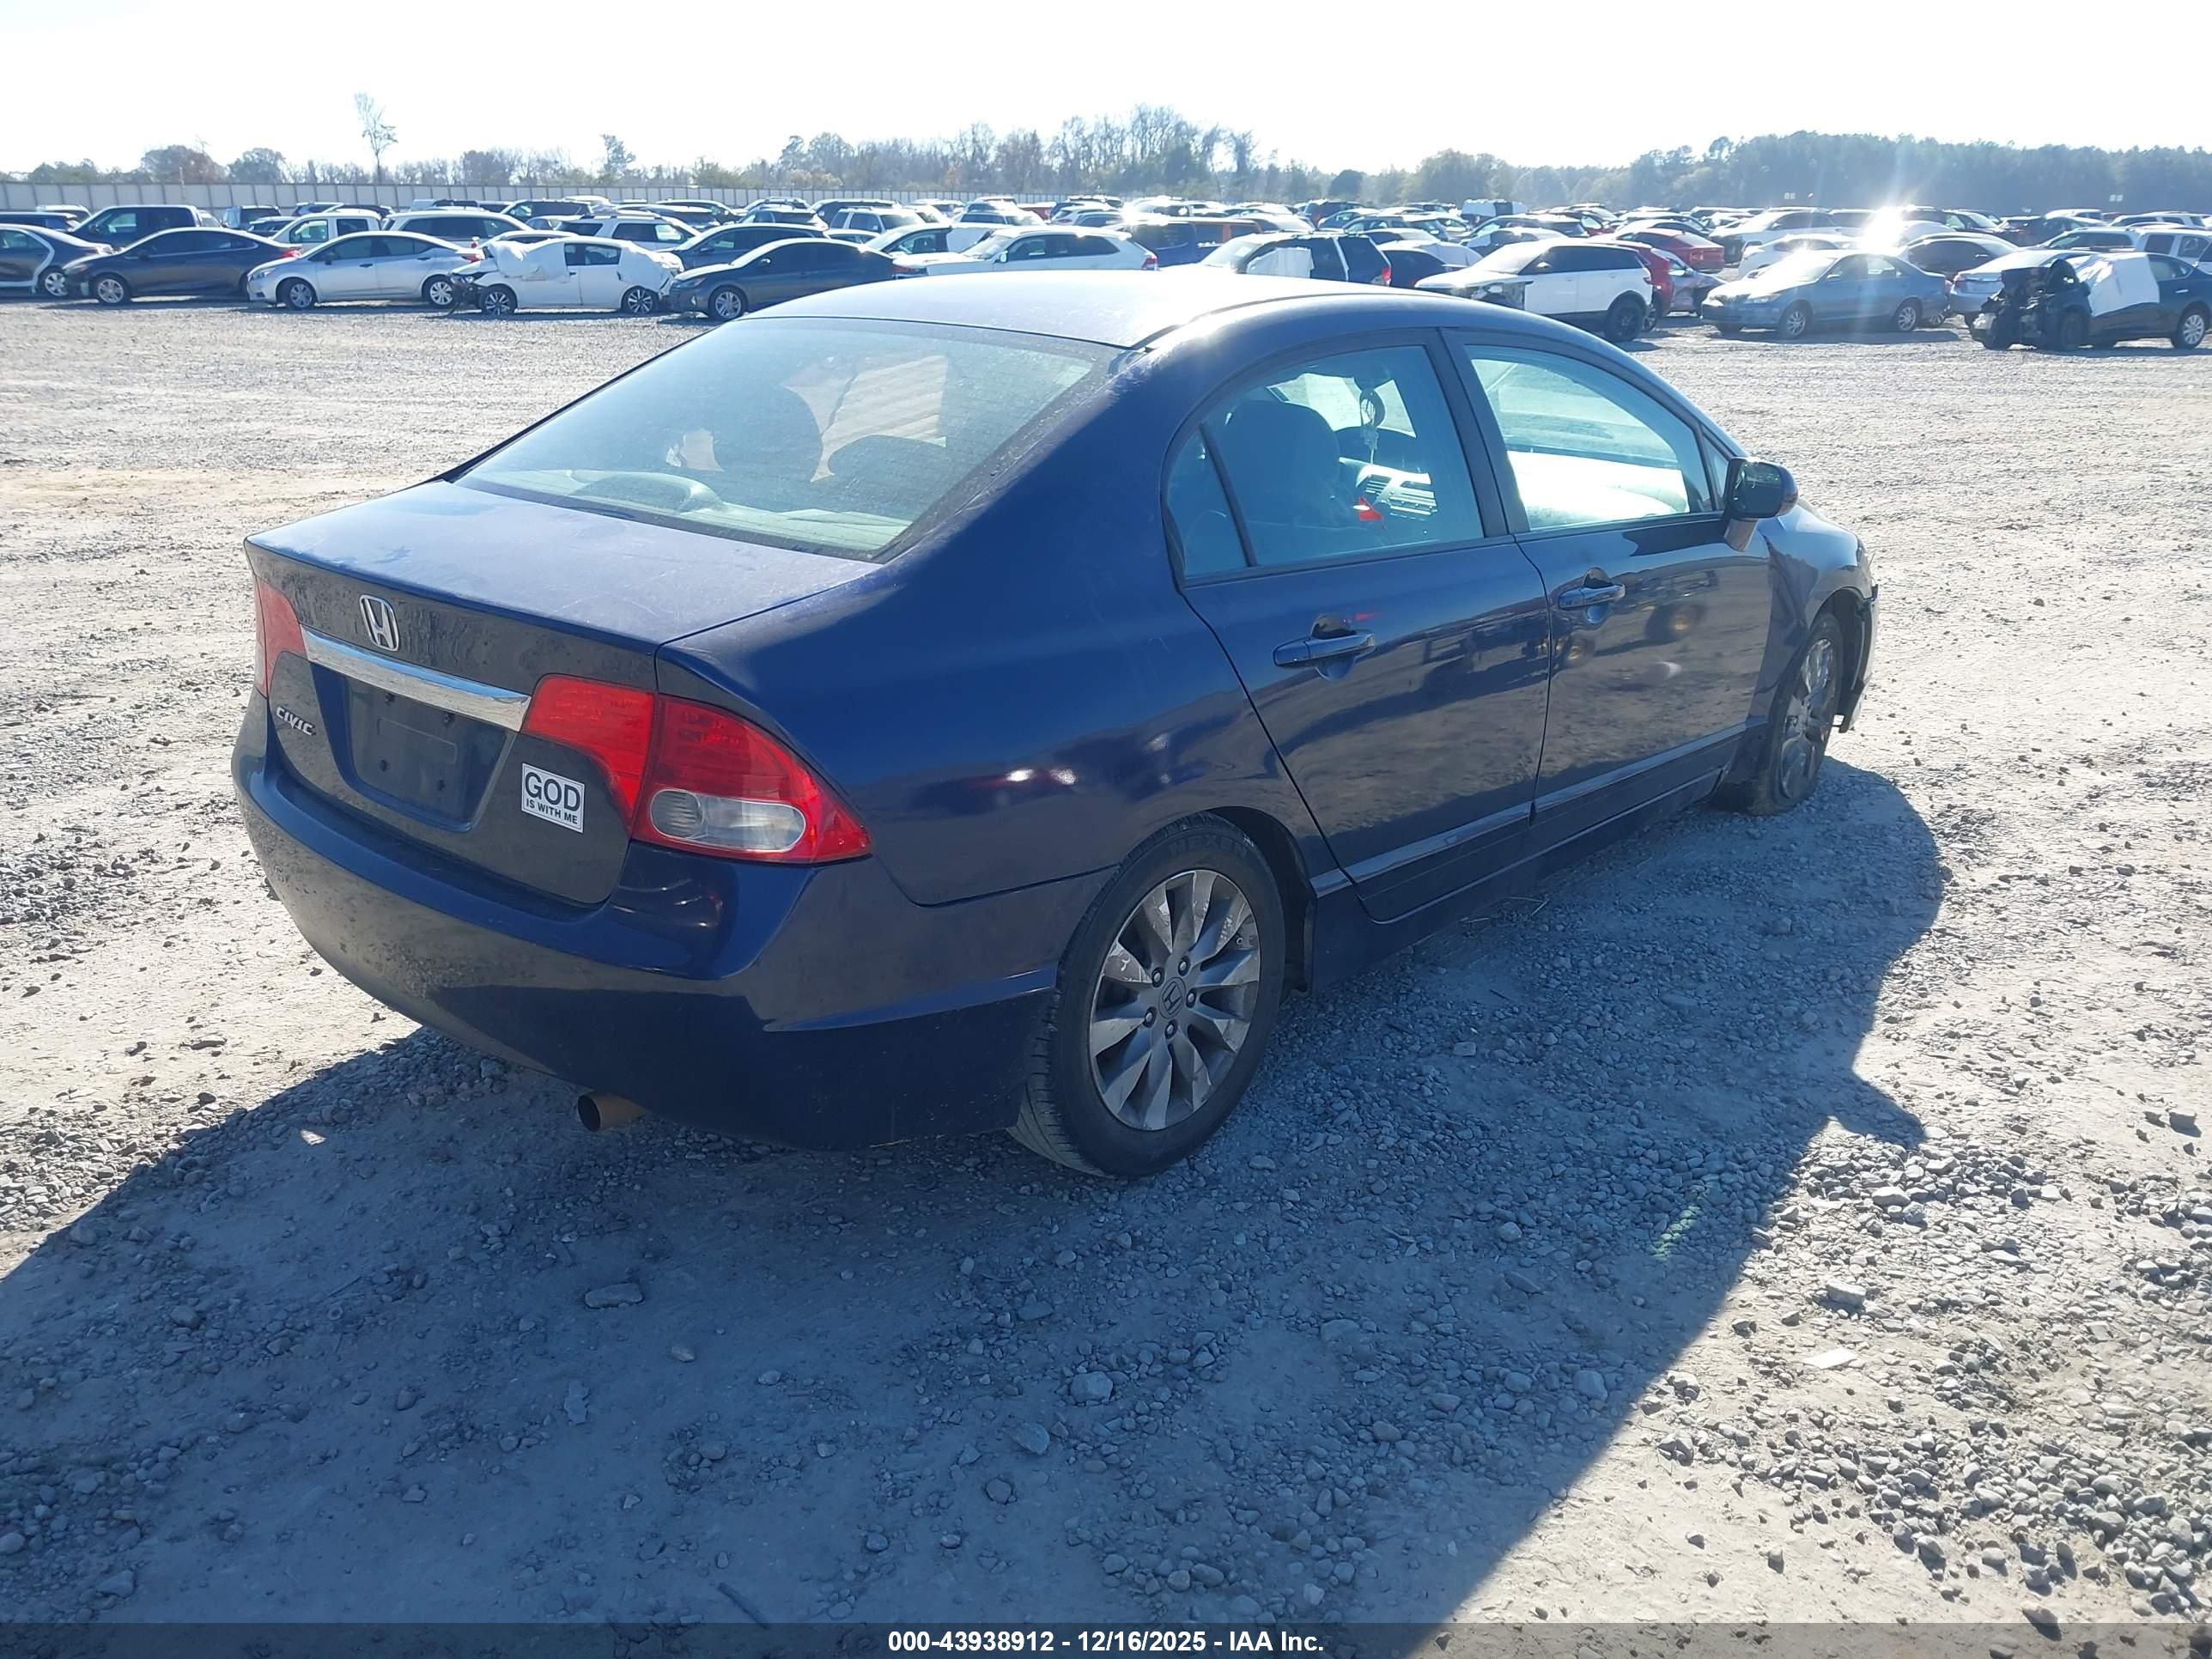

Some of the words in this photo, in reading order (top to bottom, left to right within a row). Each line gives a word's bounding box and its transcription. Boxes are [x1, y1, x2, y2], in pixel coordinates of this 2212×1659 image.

[276, 706, 314, 736] CIVIC
[525, 771, 580, 811] GOD
[526, 798, 535, 809] IS
[538, 802, 562, 818] WITH
[563, 811, 578, 825] ME
